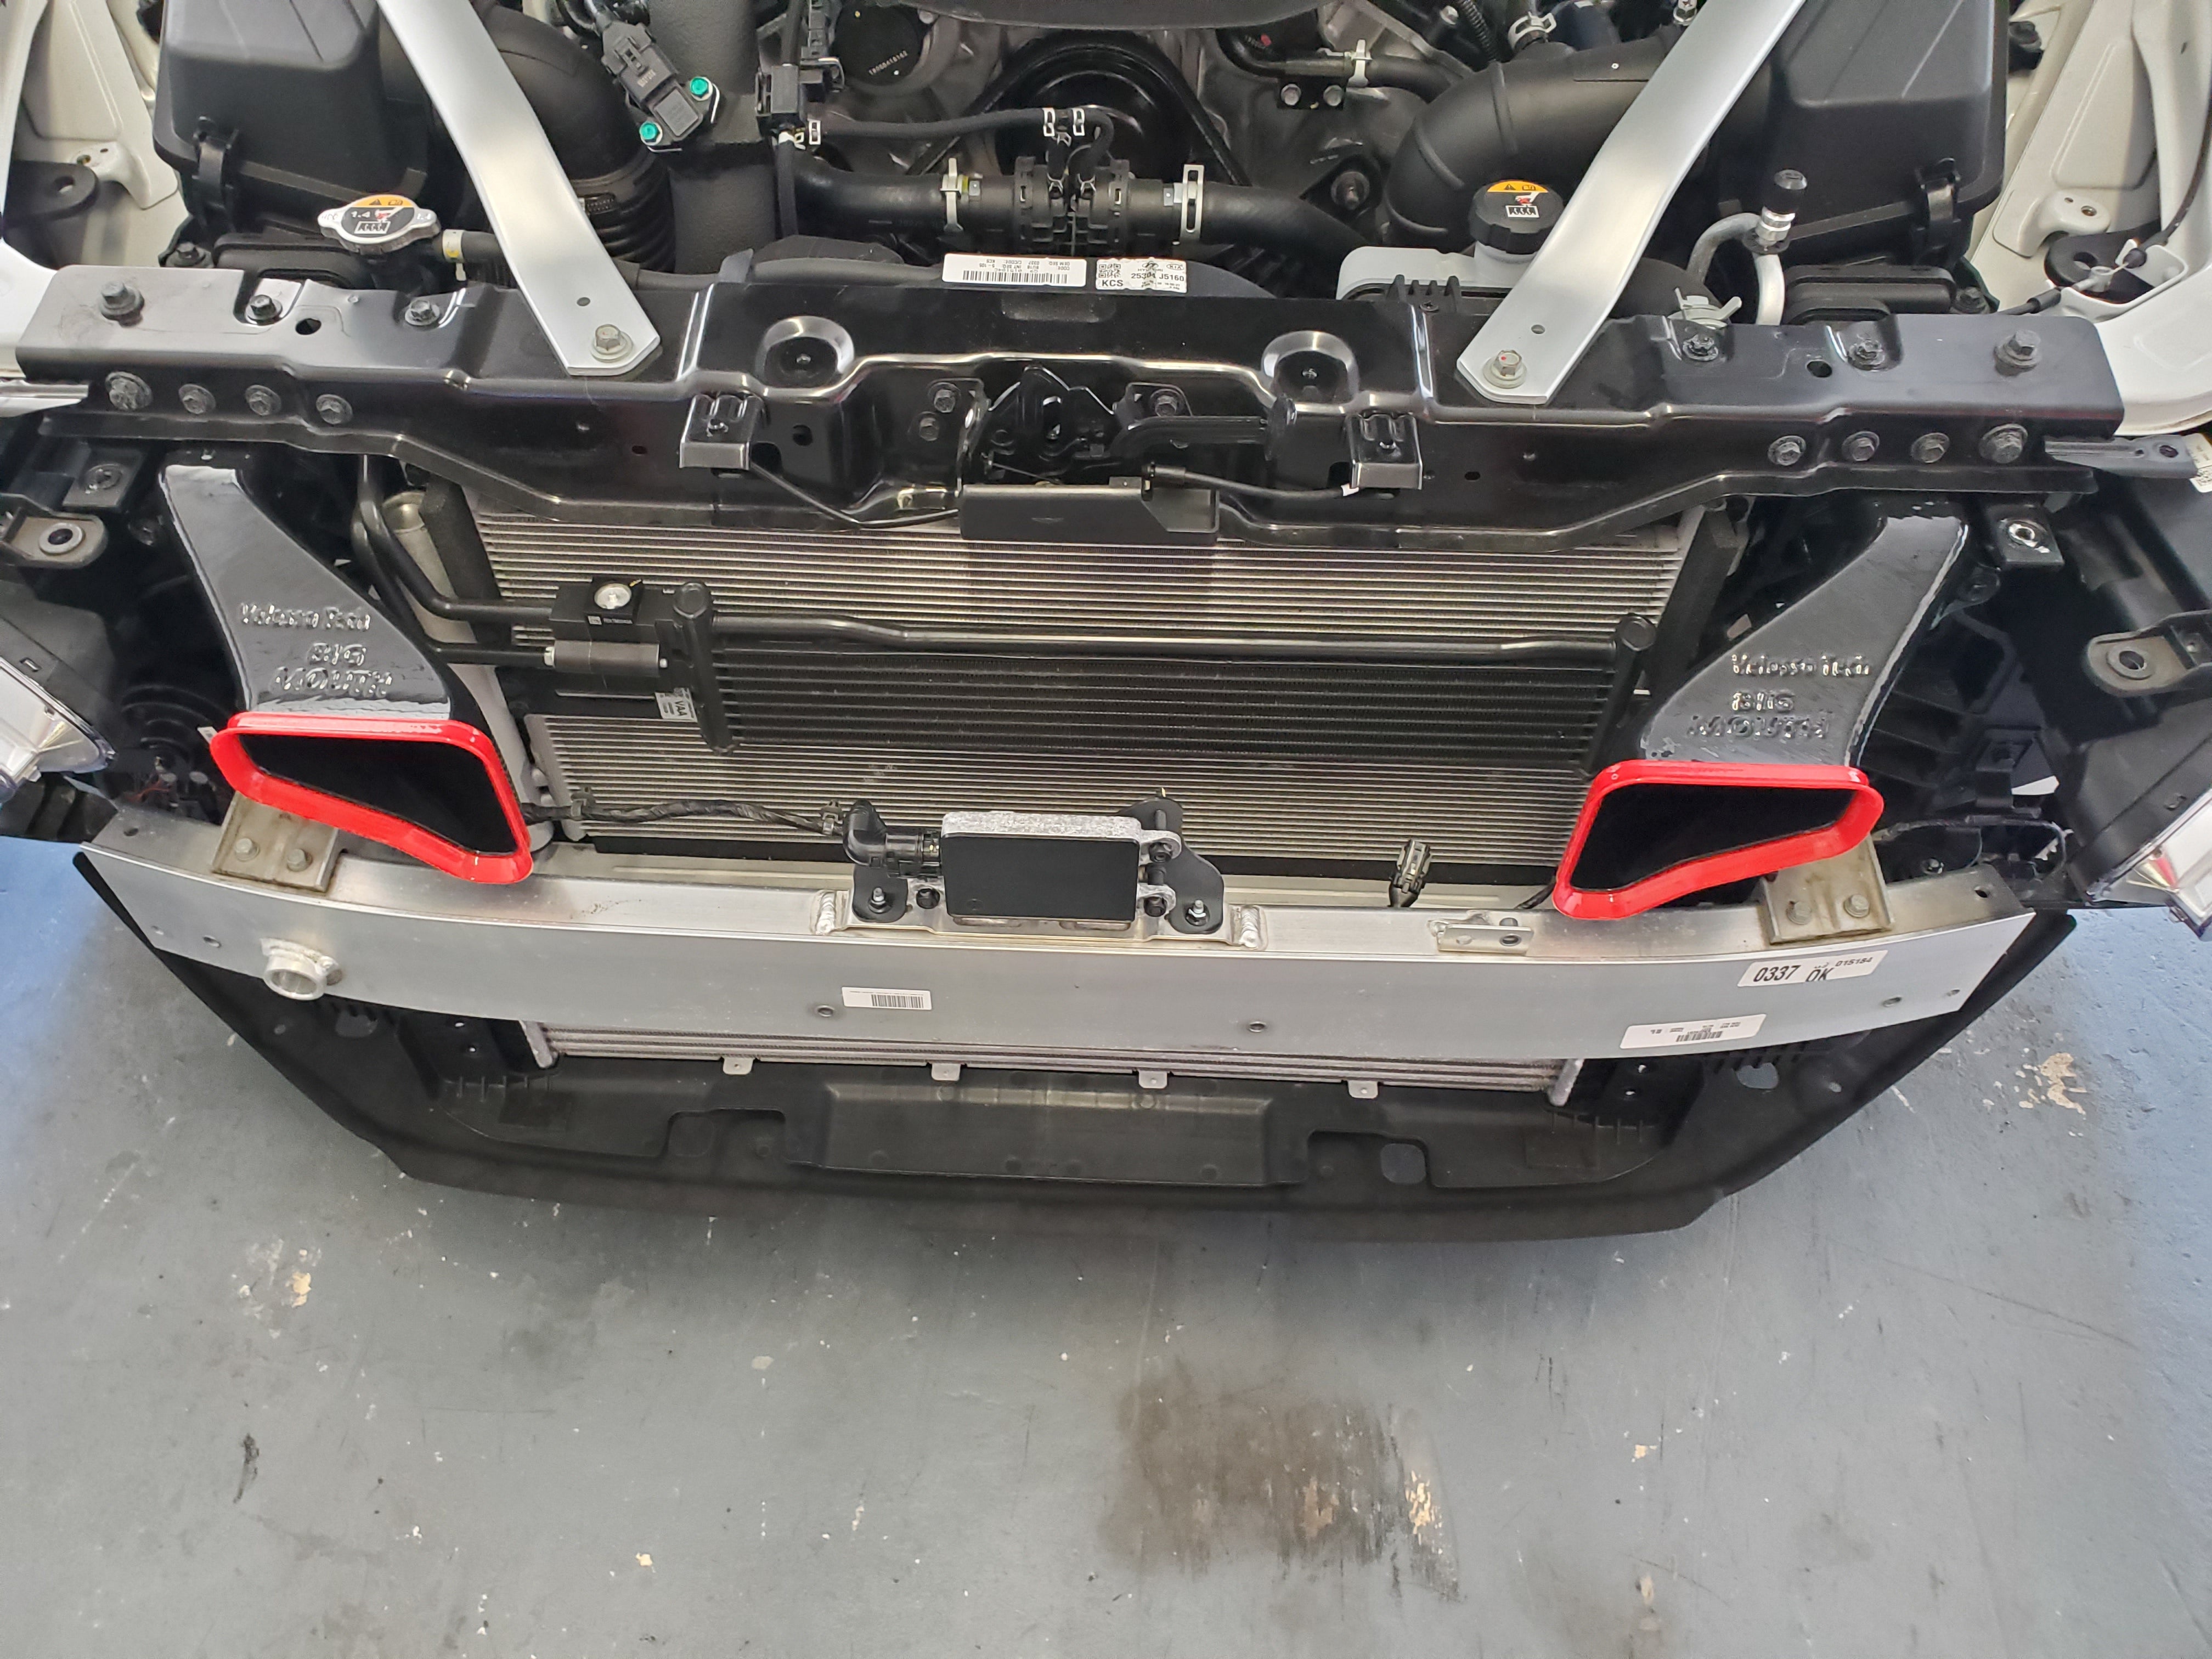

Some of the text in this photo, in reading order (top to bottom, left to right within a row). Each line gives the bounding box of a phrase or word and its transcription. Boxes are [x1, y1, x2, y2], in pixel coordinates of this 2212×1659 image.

[1835, 957, 1874, 967] 015184
[1753, 964, 1833, 983] 0337 OK
